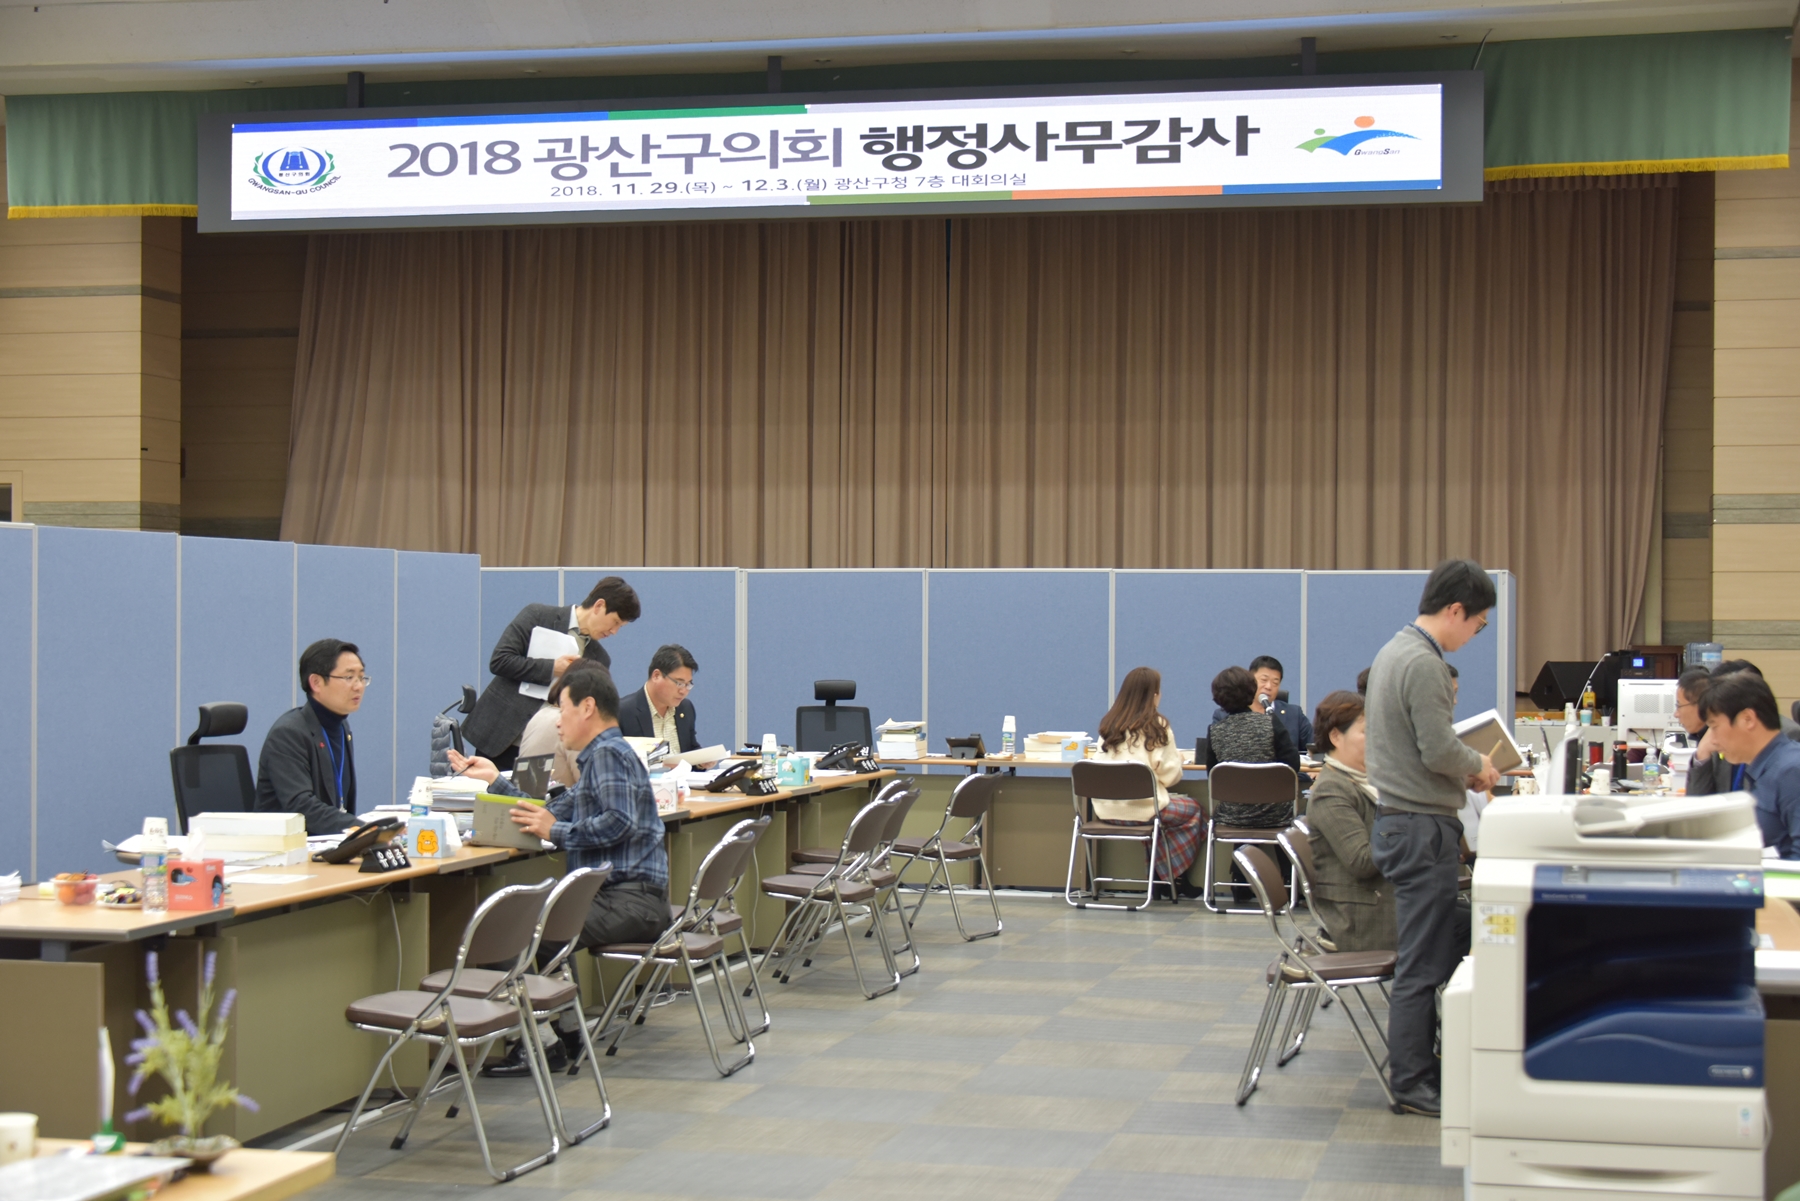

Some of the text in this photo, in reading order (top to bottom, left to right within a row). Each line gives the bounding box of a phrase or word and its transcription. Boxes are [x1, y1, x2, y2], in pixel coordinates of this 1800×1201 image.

[388, 115, 1261, 182] 2018 광산구의회 행정사무감사
[309, 175, 341, 193] COUNCIL
[550, 185, 603, 198] 2018.
[612, 183, 643, 196] 11.
[834, 176, 908, 191] 광산구청
[915, 175, 945, 188] 7층
[952, 173, 1027, 187] 대회의실
